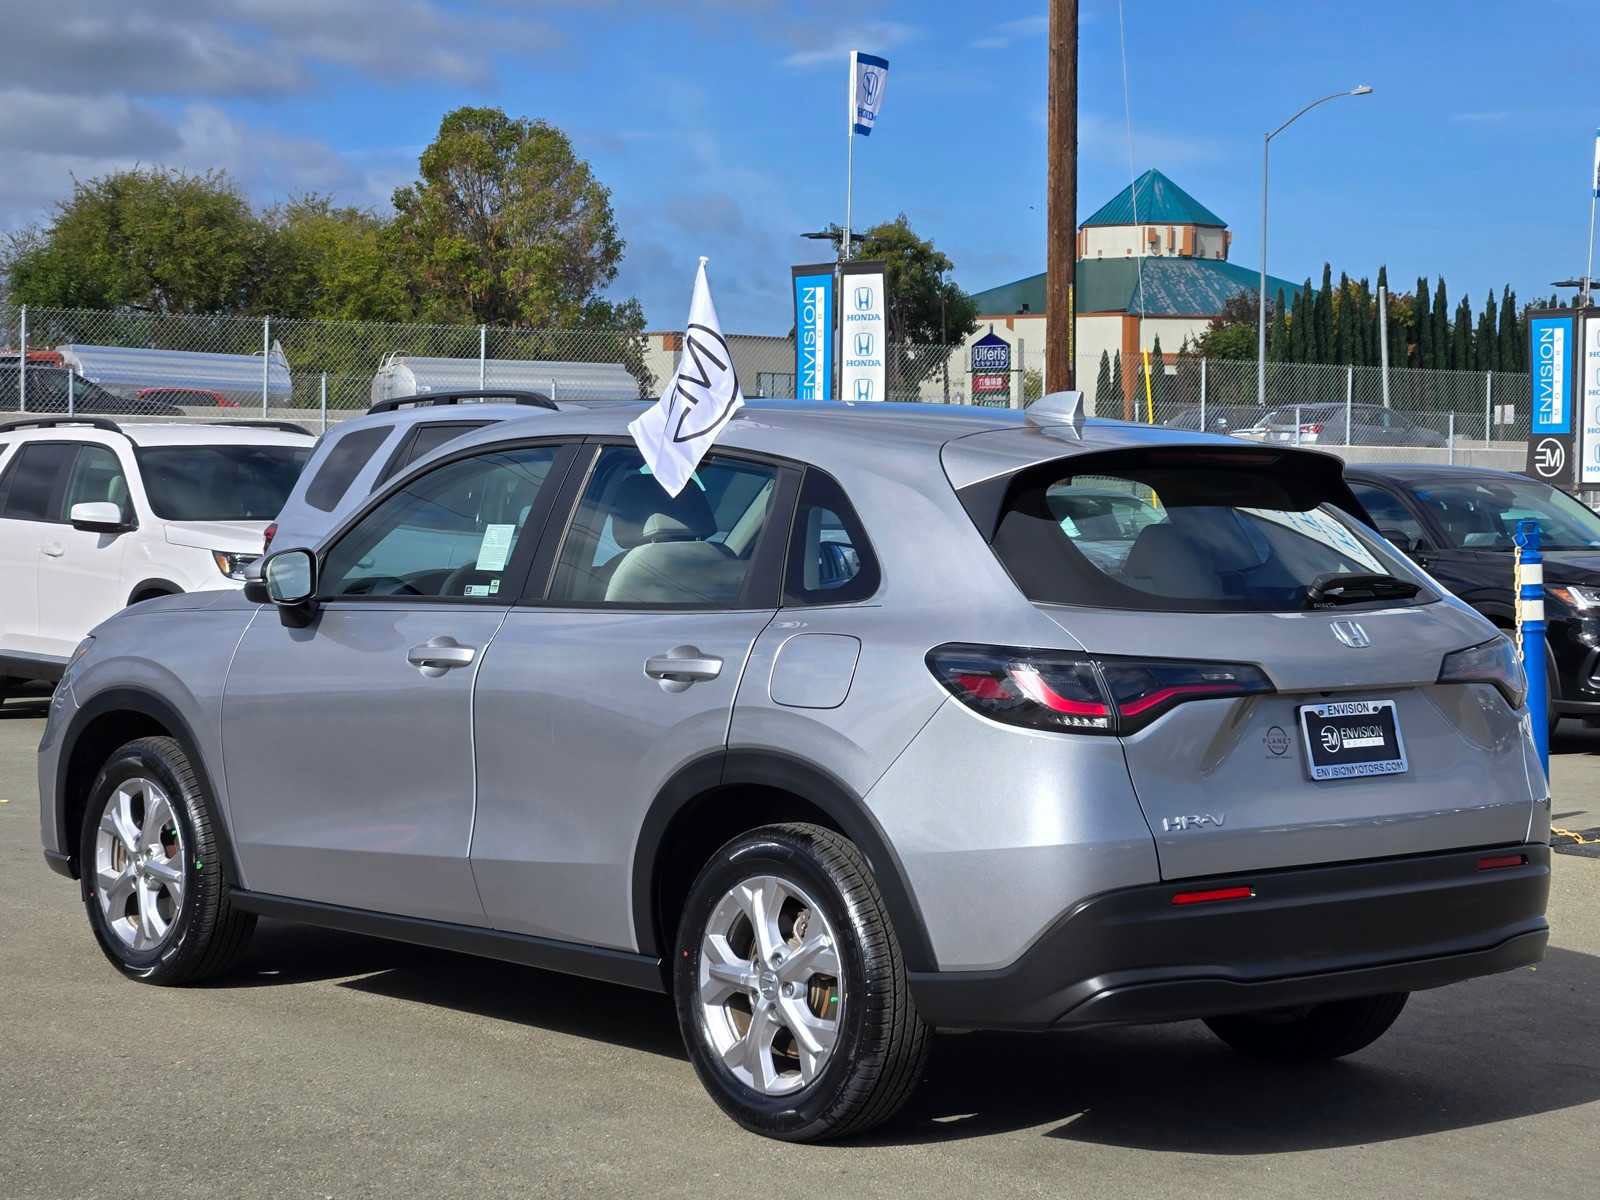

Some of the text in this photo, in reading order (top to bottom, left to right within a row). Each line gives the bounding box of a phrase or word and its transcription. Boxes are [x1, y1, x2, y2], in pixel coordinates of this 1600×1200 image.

[846, 313, 881, 321] HONDA
[803, 287, 816, 400] ENVISION
[846, 359, 881, 367] HONDA
[1539, 328, 1553, 424] ENVISION
[1328, 703, 1370, 716] ENVISION
[1340, 725, 1383, 739] ENVISION
[1316, 761, 1404, 777] ENVISIONMOTORS.COM
[1162, 812, 1225, 832] HR-V
